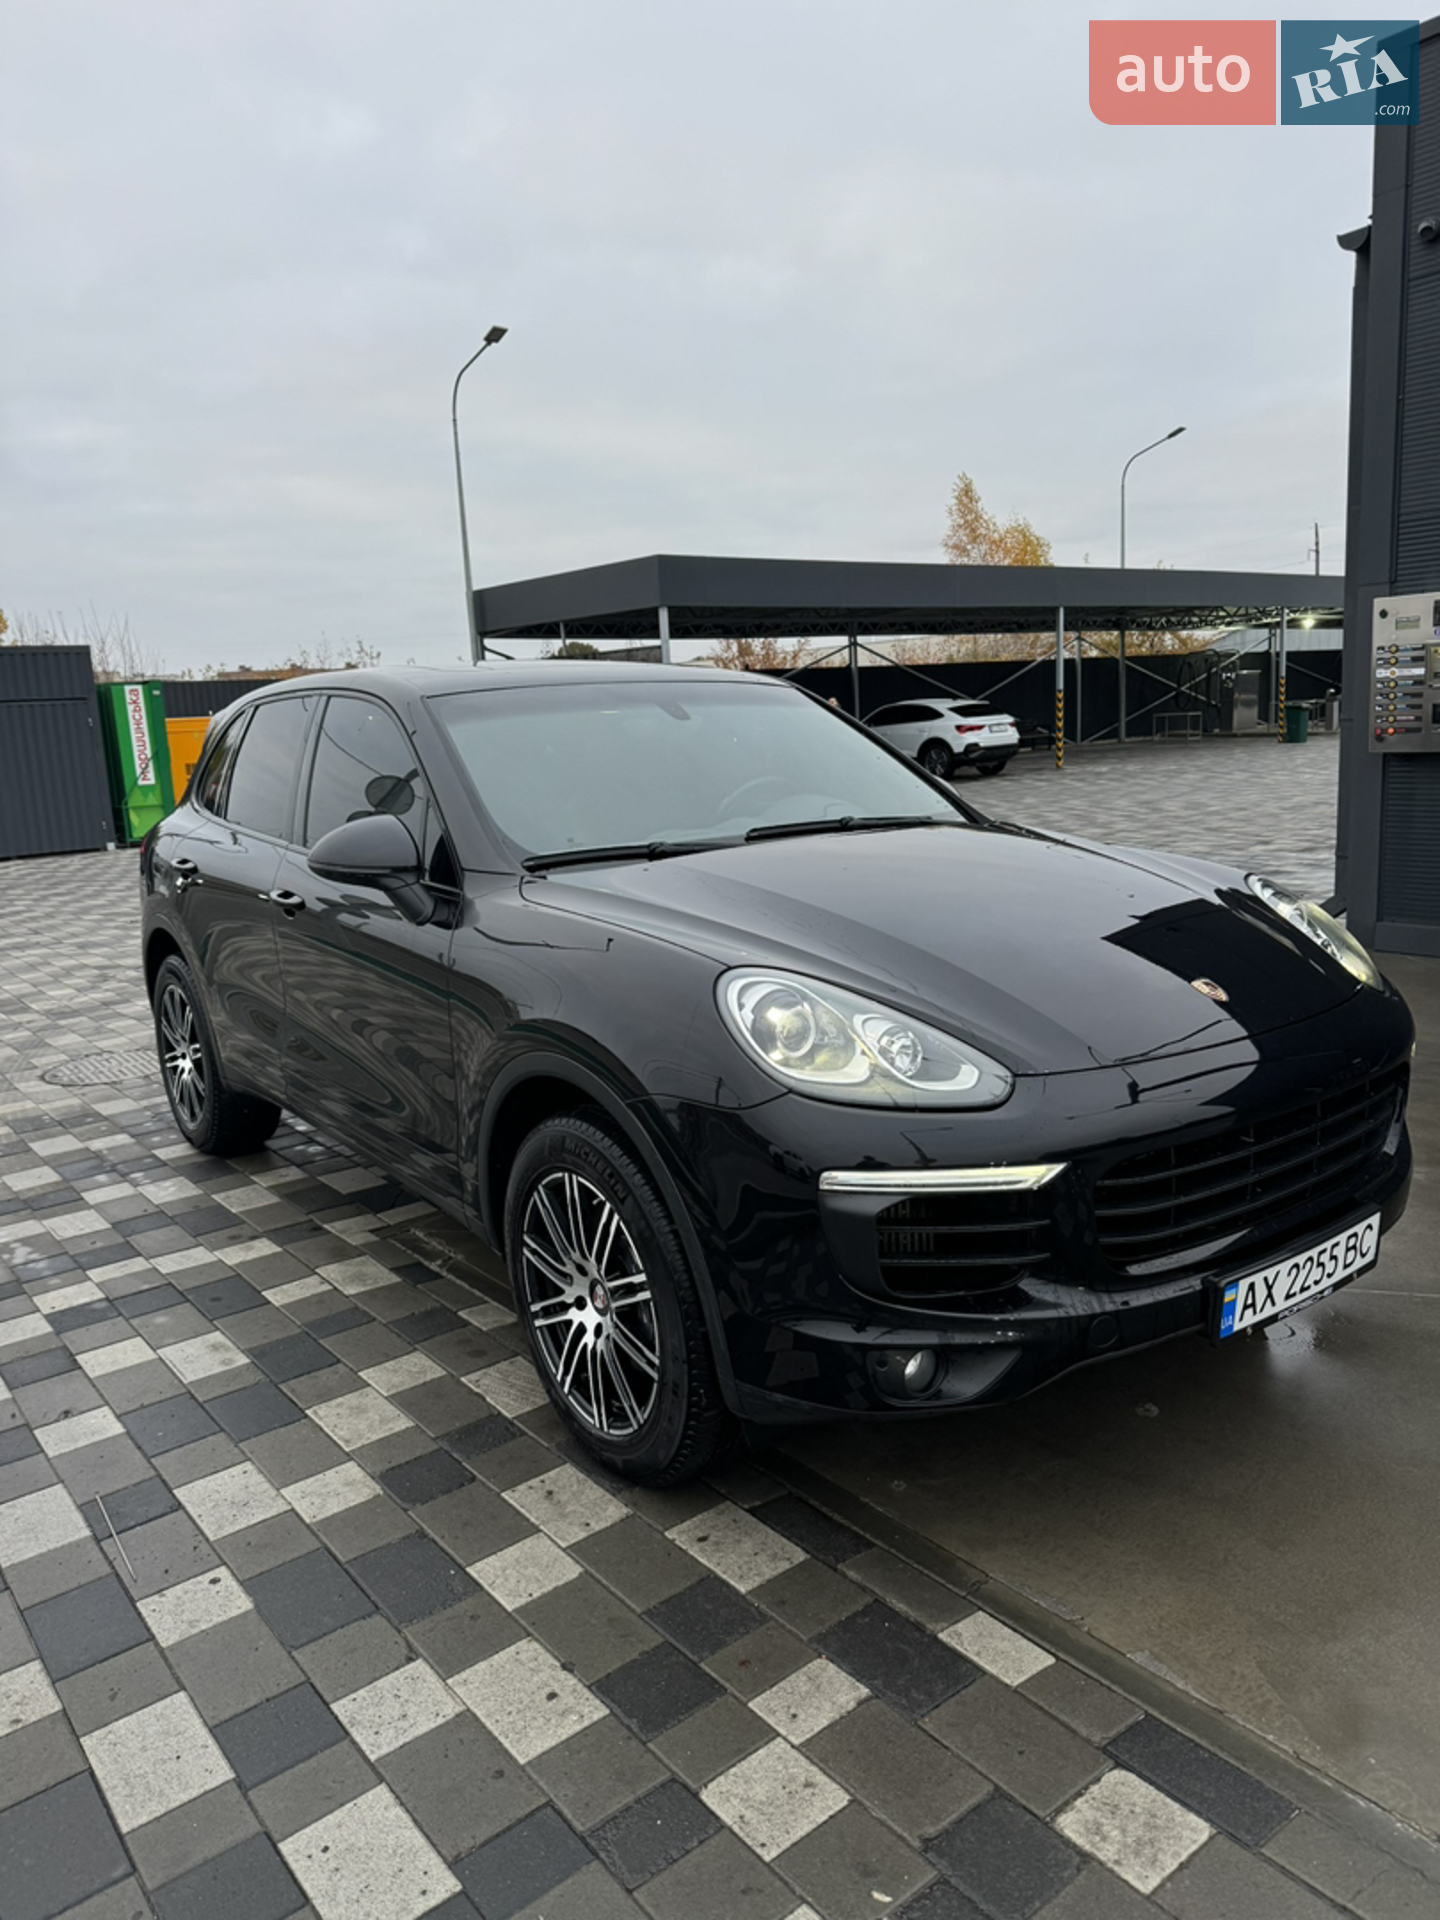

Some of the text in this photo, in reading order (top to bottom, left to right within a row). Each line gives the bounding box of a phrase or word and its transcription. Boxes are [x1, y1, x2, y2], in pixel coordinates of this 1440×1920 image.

[564, 1136, 627, 1200] MICHELIN
[1239, 1270, 1280, 1322] AX
[1284, 1240, 1341, 1302] 2255
[1342, 1223, 1373, 1270] BC
